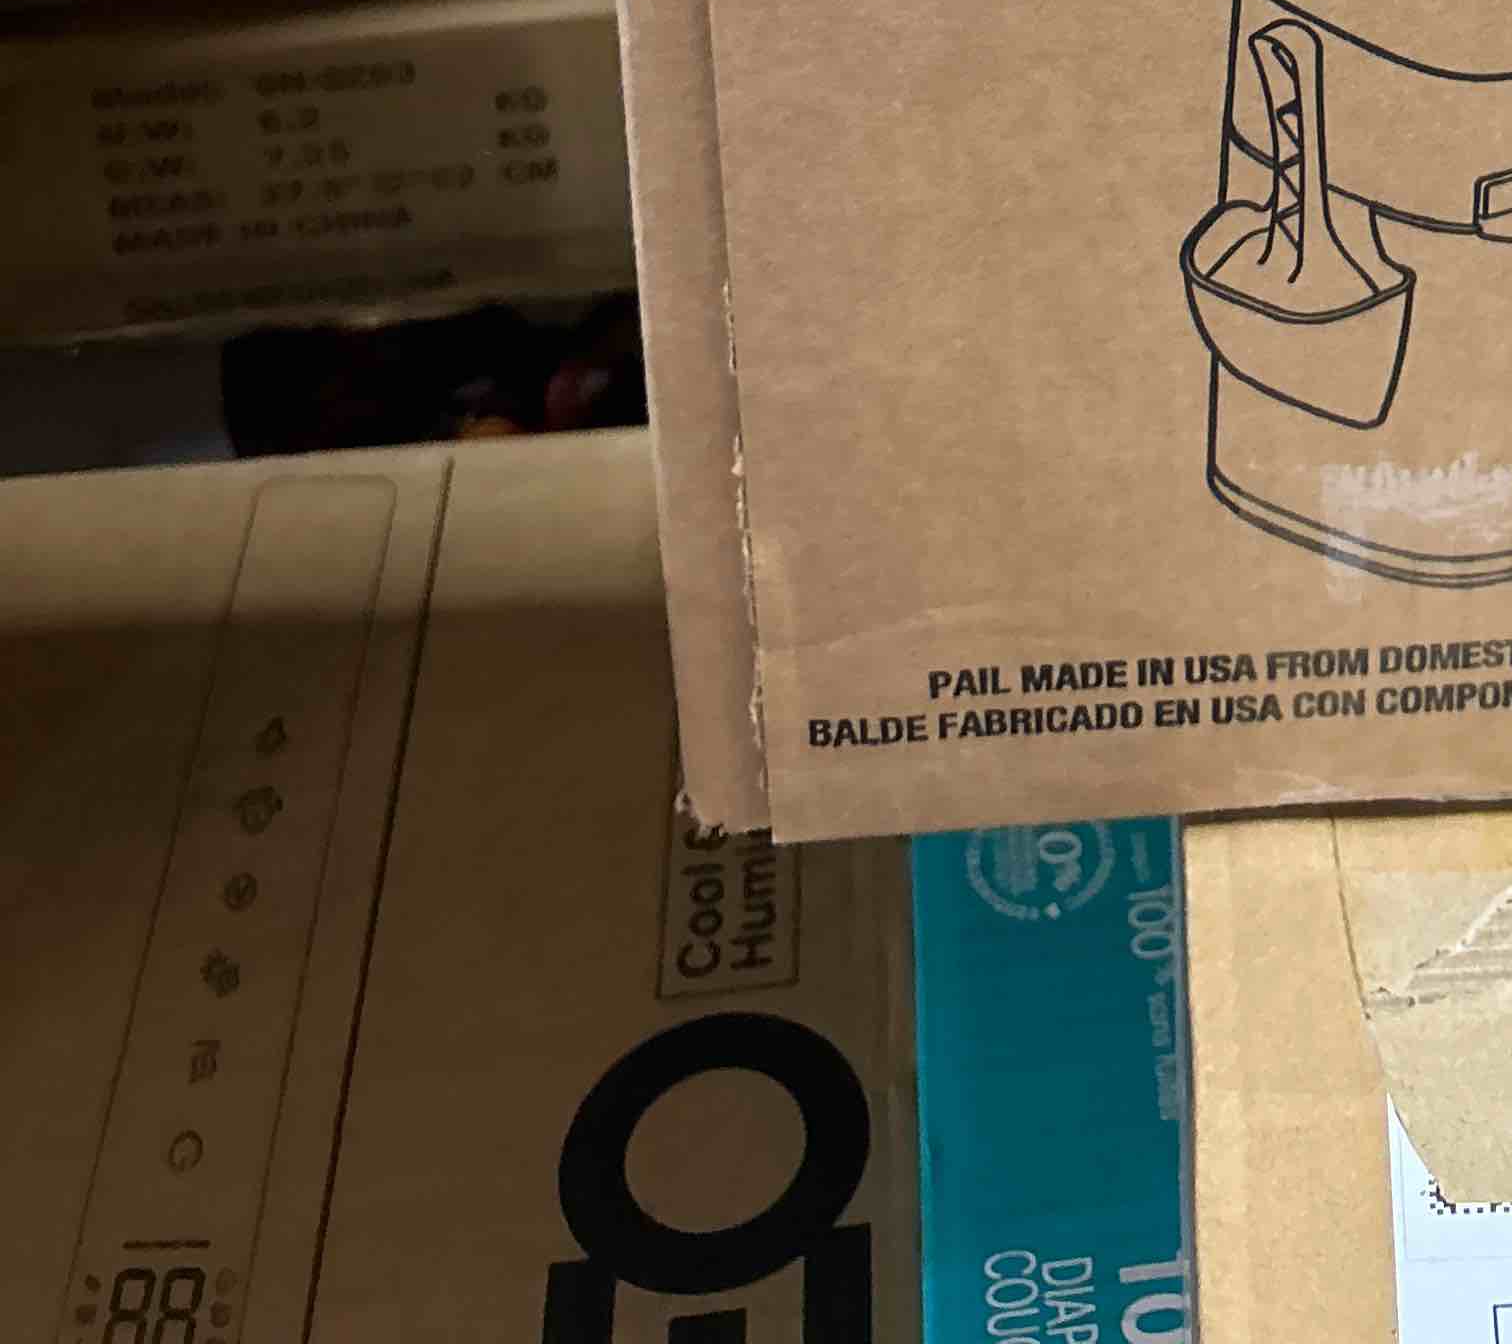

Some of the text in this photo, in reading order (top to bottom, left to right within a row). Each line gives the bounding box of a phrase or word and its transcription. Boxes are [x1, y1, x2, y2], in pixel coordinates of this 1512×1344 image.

[928, 665, 1011, 700] PAIL
[1020, 659, 1129, 694] MADE
[1136, 656, 1176, 687] IN
[1184, 653, 1258, 684] USA
[1266, 648, 1369, 681] FROM
[807, 714, 930, 748] BALDE
[937, 701, 1143, 740] FABRICADO
[1154, 697, 1201, 727] EN
[1210, 692, 1284, 724] USA
[1292, 689, 1367, 720] CON
[677, 864, 724, 979] Cool
